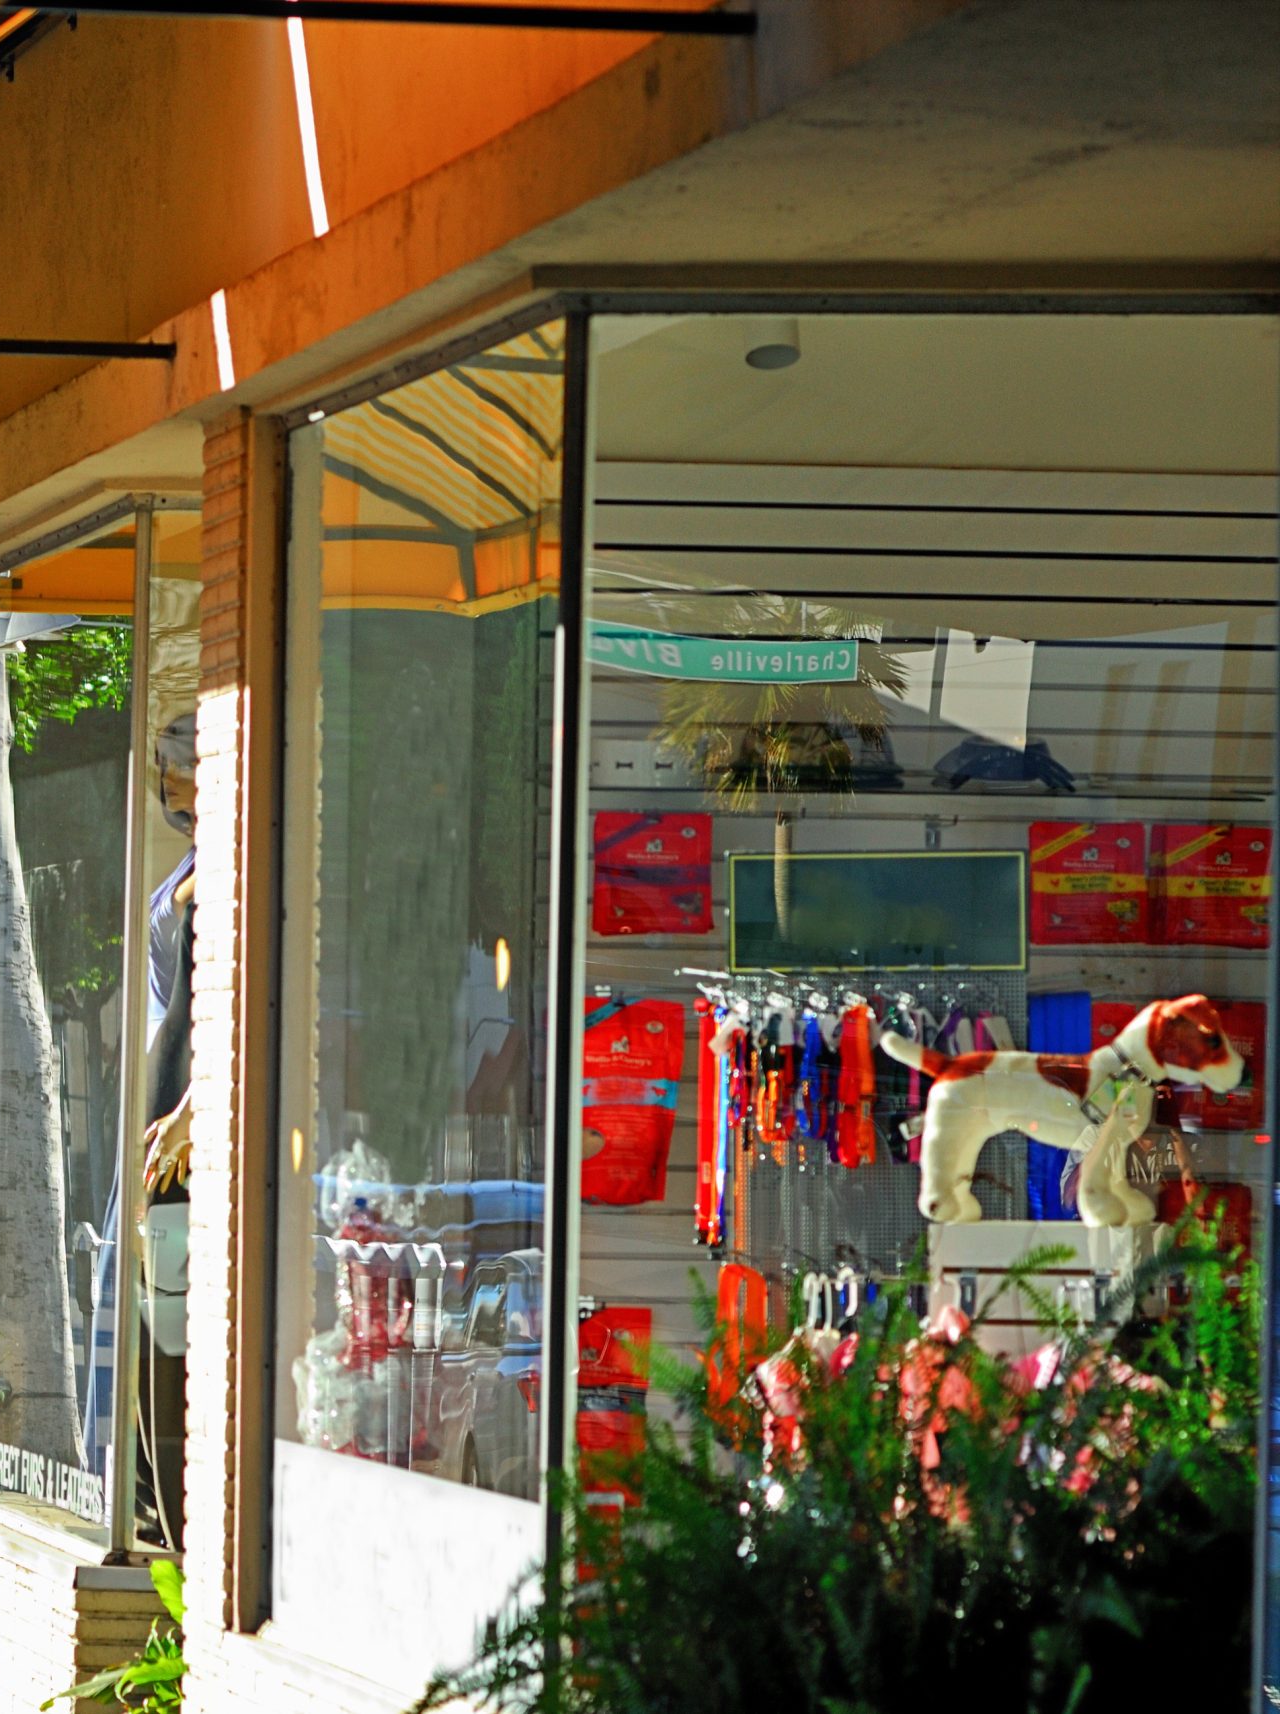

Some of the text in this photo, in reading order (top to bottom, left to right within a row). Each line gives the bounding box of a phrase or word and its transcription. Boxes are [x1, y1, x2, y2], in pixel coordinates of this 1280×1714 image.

[20, 1449, 45, 1501] FURS
[47, 1458, 54, 1504] &
[55, 1461, 103, 1524] LEATHERS
